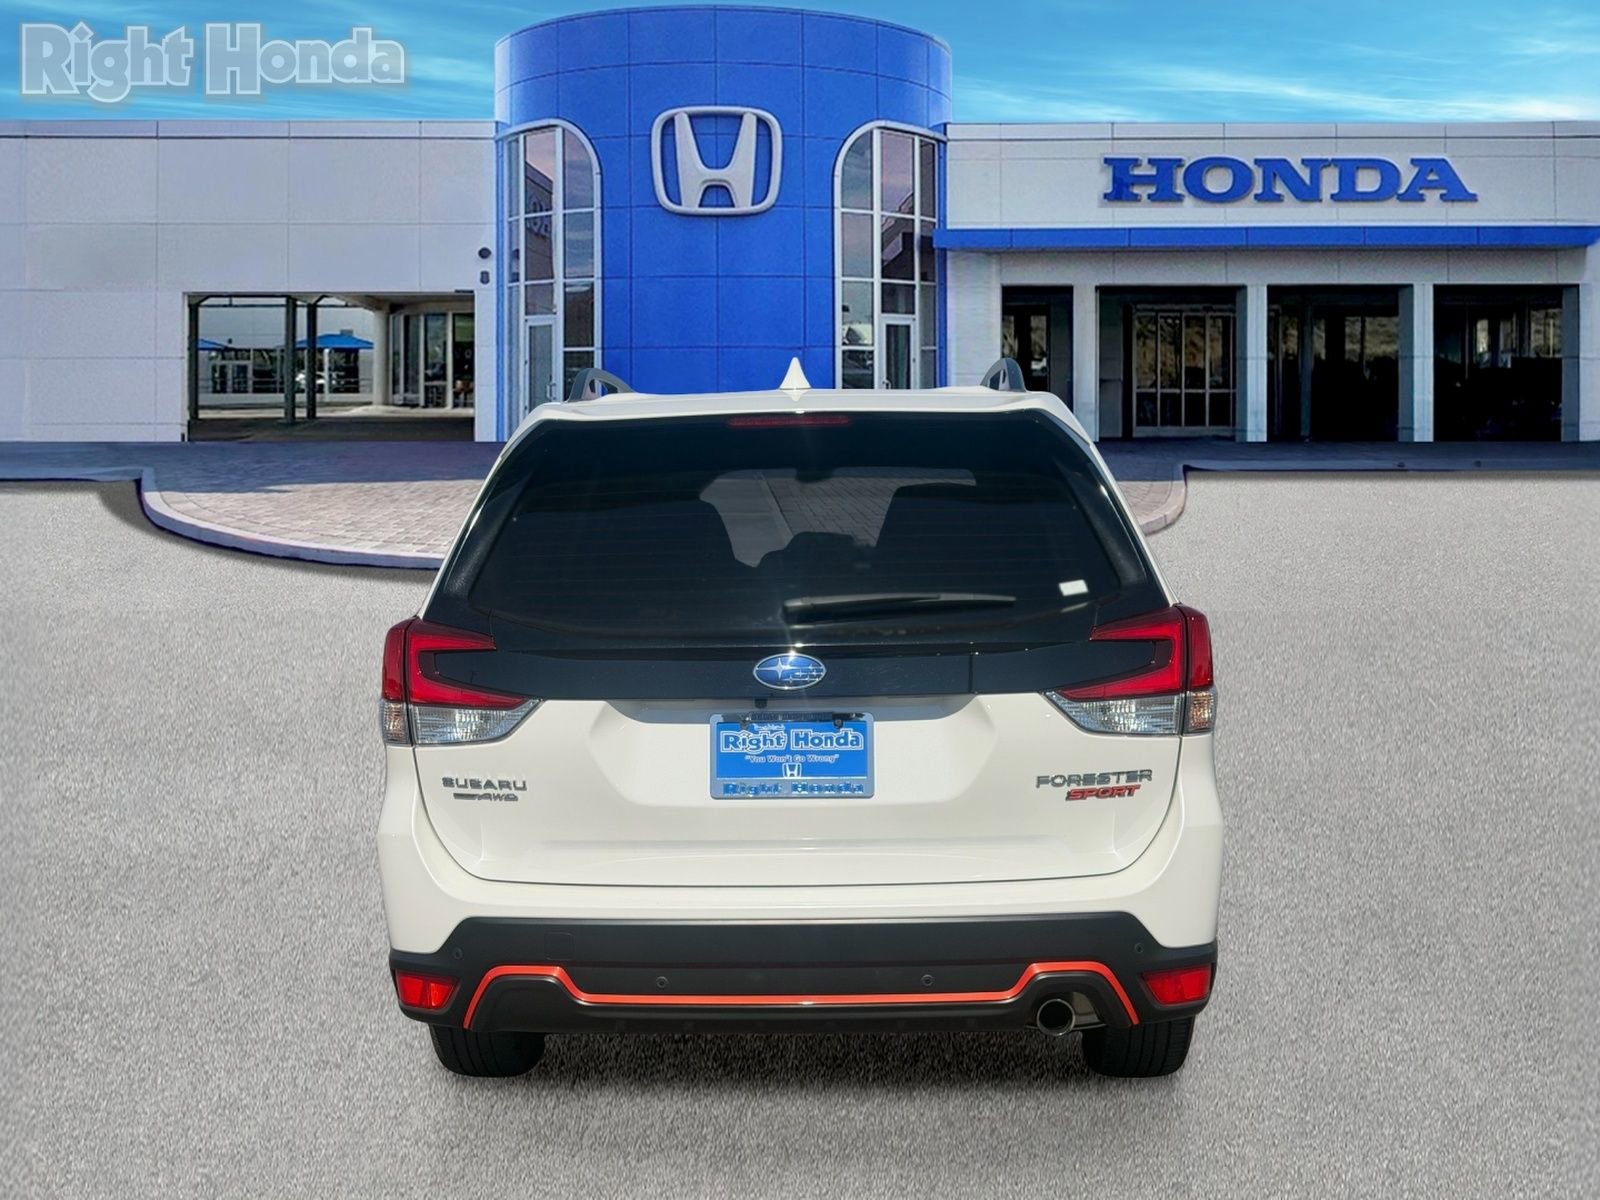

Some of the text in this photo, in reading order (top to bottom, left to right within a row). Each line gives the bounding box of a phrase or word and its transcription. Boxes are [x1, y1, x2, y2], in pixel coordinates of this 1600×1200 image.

[1103, 155, 1479, 203] HONDA
[721, 729, 864, 754] Right Honda
[793, 754, 806, 763] Go
[441, 777, 527, 791] SUBARU
[1035, 769, 1153, 788] FORESTER
[723, 782, 864, 796] Right Honda
[1065, 784, 1141, 801] SPORT
[477, 793, 519, 802] AWD
